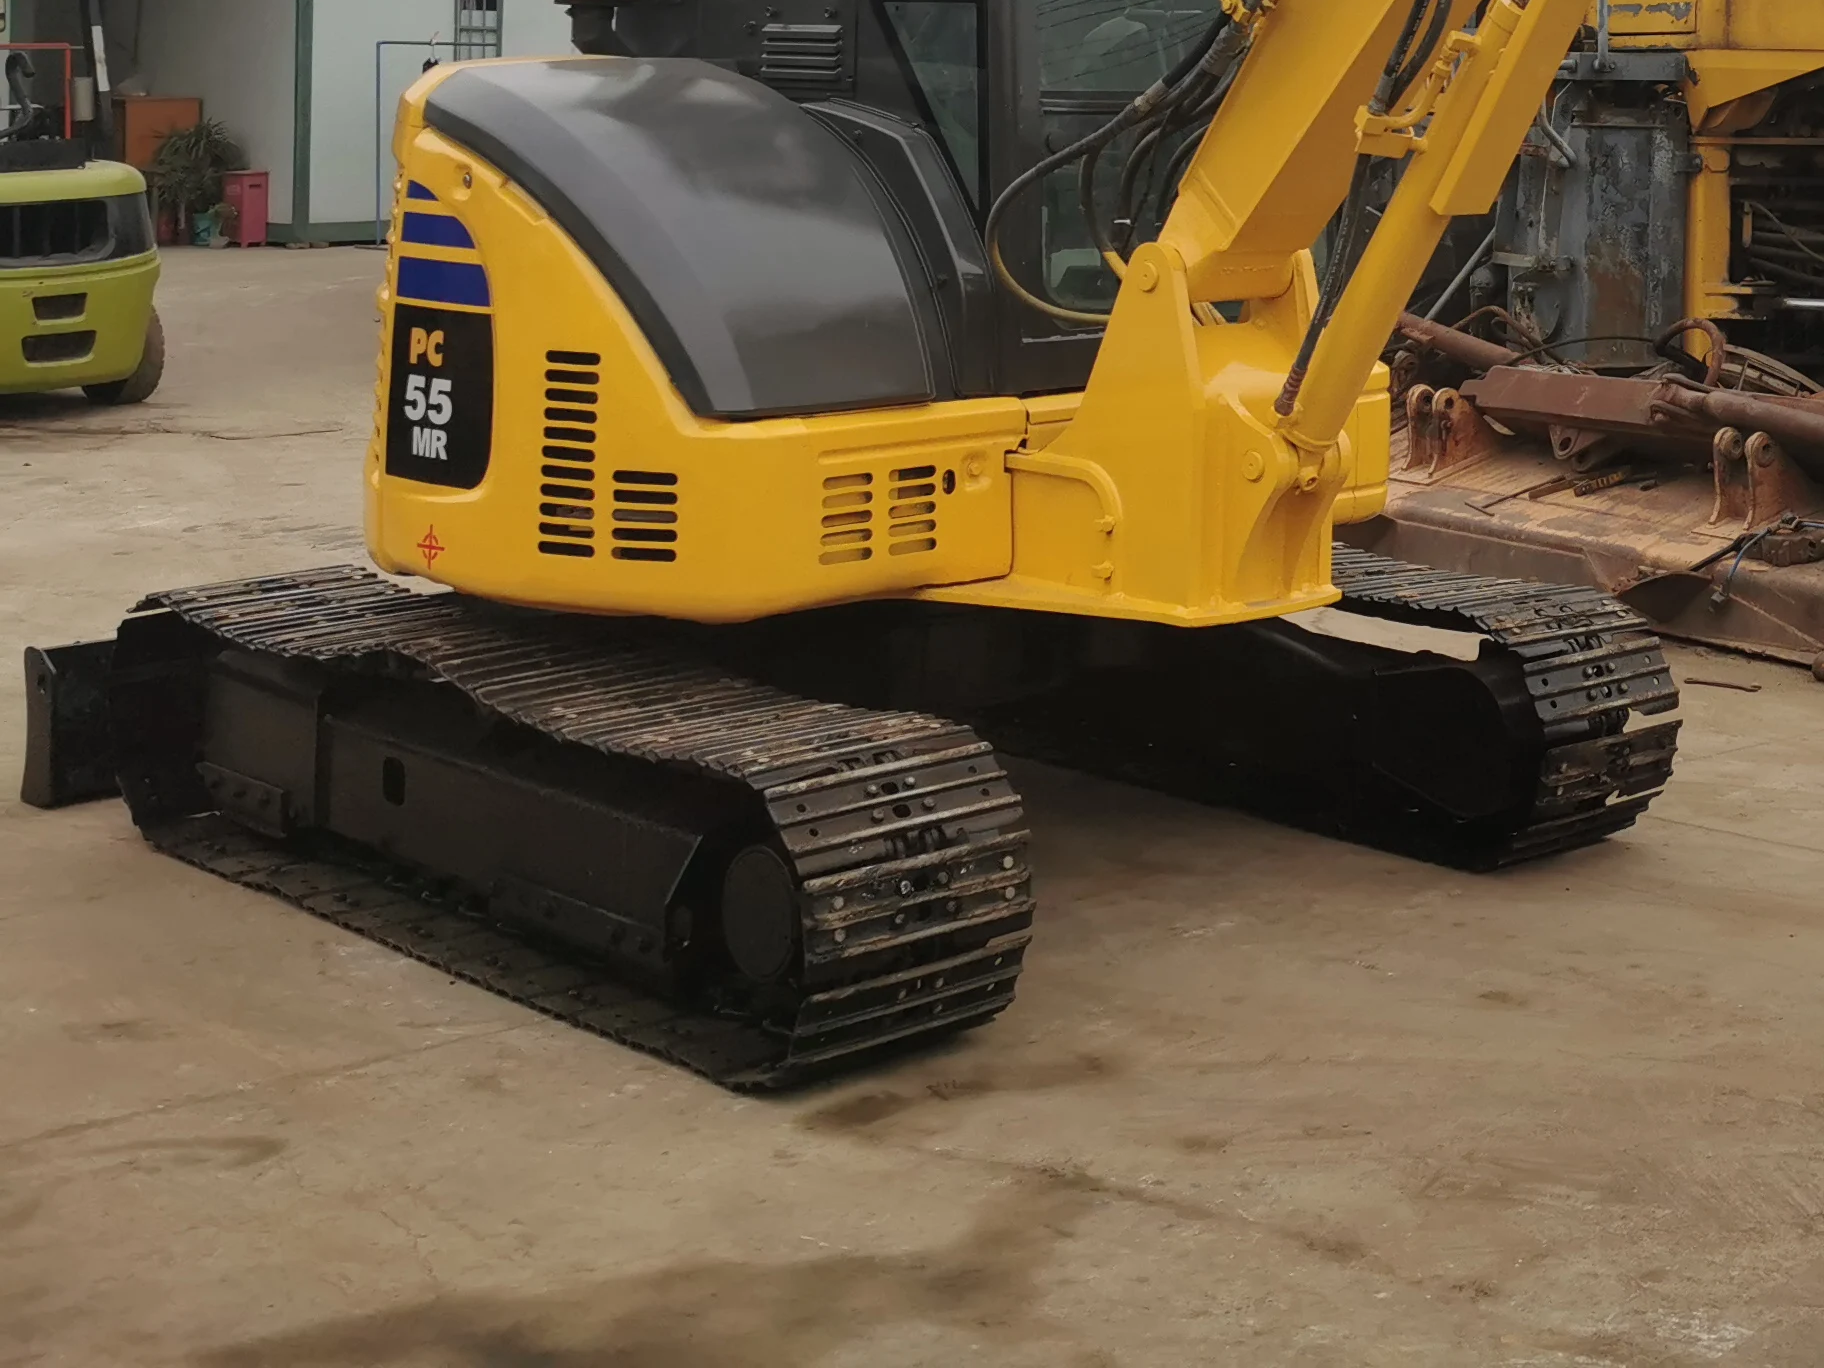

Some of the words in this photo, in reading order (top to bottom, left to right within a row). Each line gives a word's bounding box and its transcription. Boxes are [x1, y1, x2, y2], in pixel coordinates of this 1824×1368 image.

[409, 327, 444, 367] PC
[404, 374, 453, 425] 55
[412, 426, 448, 460] MR
